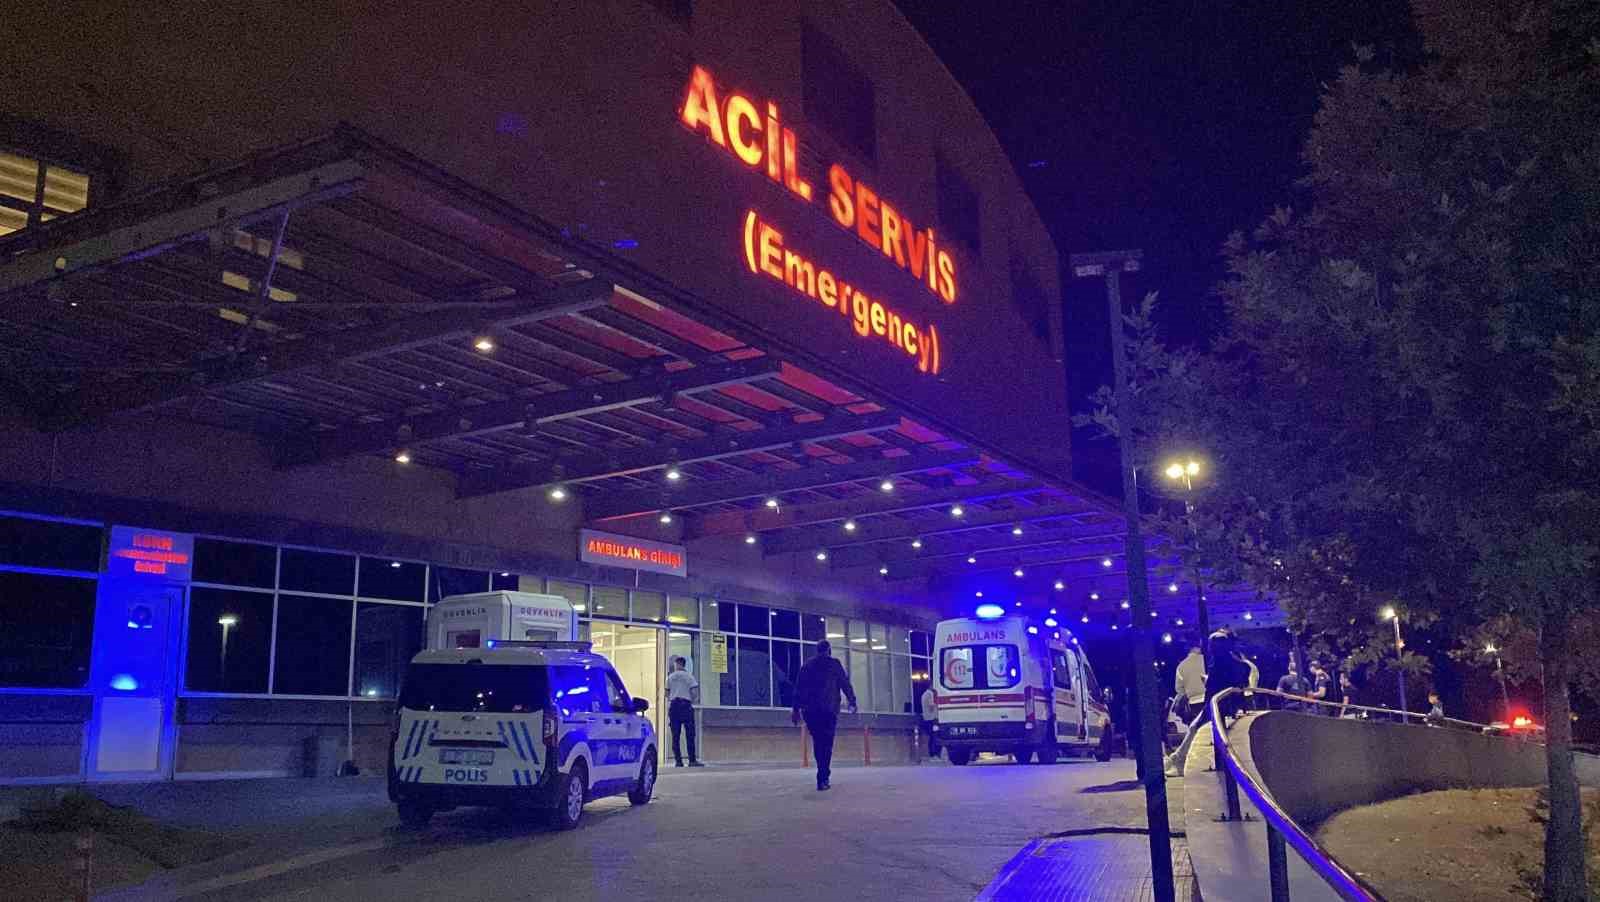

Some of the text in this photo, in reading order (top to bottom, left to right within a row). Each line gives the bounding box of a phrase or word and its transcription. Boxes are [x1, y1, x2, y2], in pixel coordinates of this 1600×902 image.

[680, 64, 956, 304] ACİL SERVİS
[744, 210, 939, 374] (Emergency)
[588, 540, 648, 561] AMBULANS
[946, 630, 1006, 642] AMBULANS
